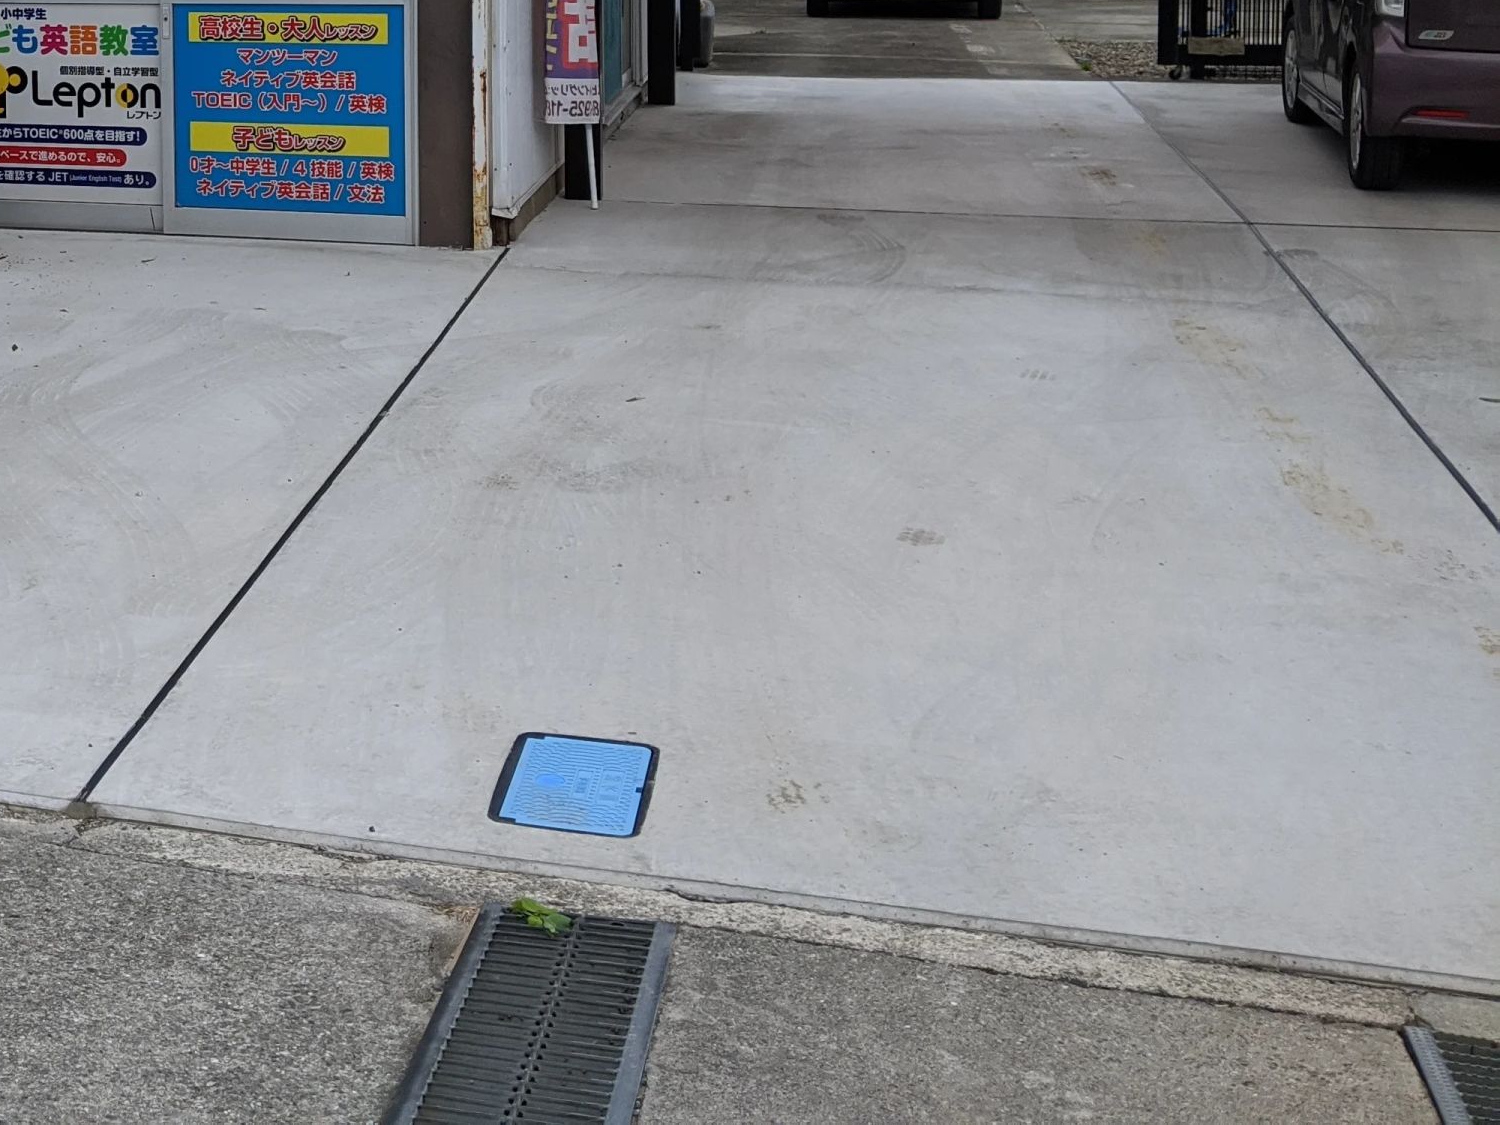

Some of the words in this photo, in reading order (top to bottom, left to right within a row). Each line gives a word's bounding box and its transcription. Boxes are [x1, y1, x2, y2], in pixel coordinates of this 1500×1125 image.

[199, 16, 377, 41] 高校生・大人レッスン
[237, 48, 337, 66] マンツーマン
[59, 66, 159, 77] 個別指導型・自立学習型
[221, 70, 356, 90] ネイティブ英会話
[31, 70, 162, 118] Lepton
[349, 94, 386, 113] 英検
[126, 111, 162, 119] レプトン
[233, 126, 345, 153] 子どもレッスン
[48, 172, 69, 182] JET
[310, 160, 342, 178] 技能
[360, 162, 395, 180] 英検
[196, 179, 330, 201] ネイティブ英会話
[348, 184, 384, 204] 文法
